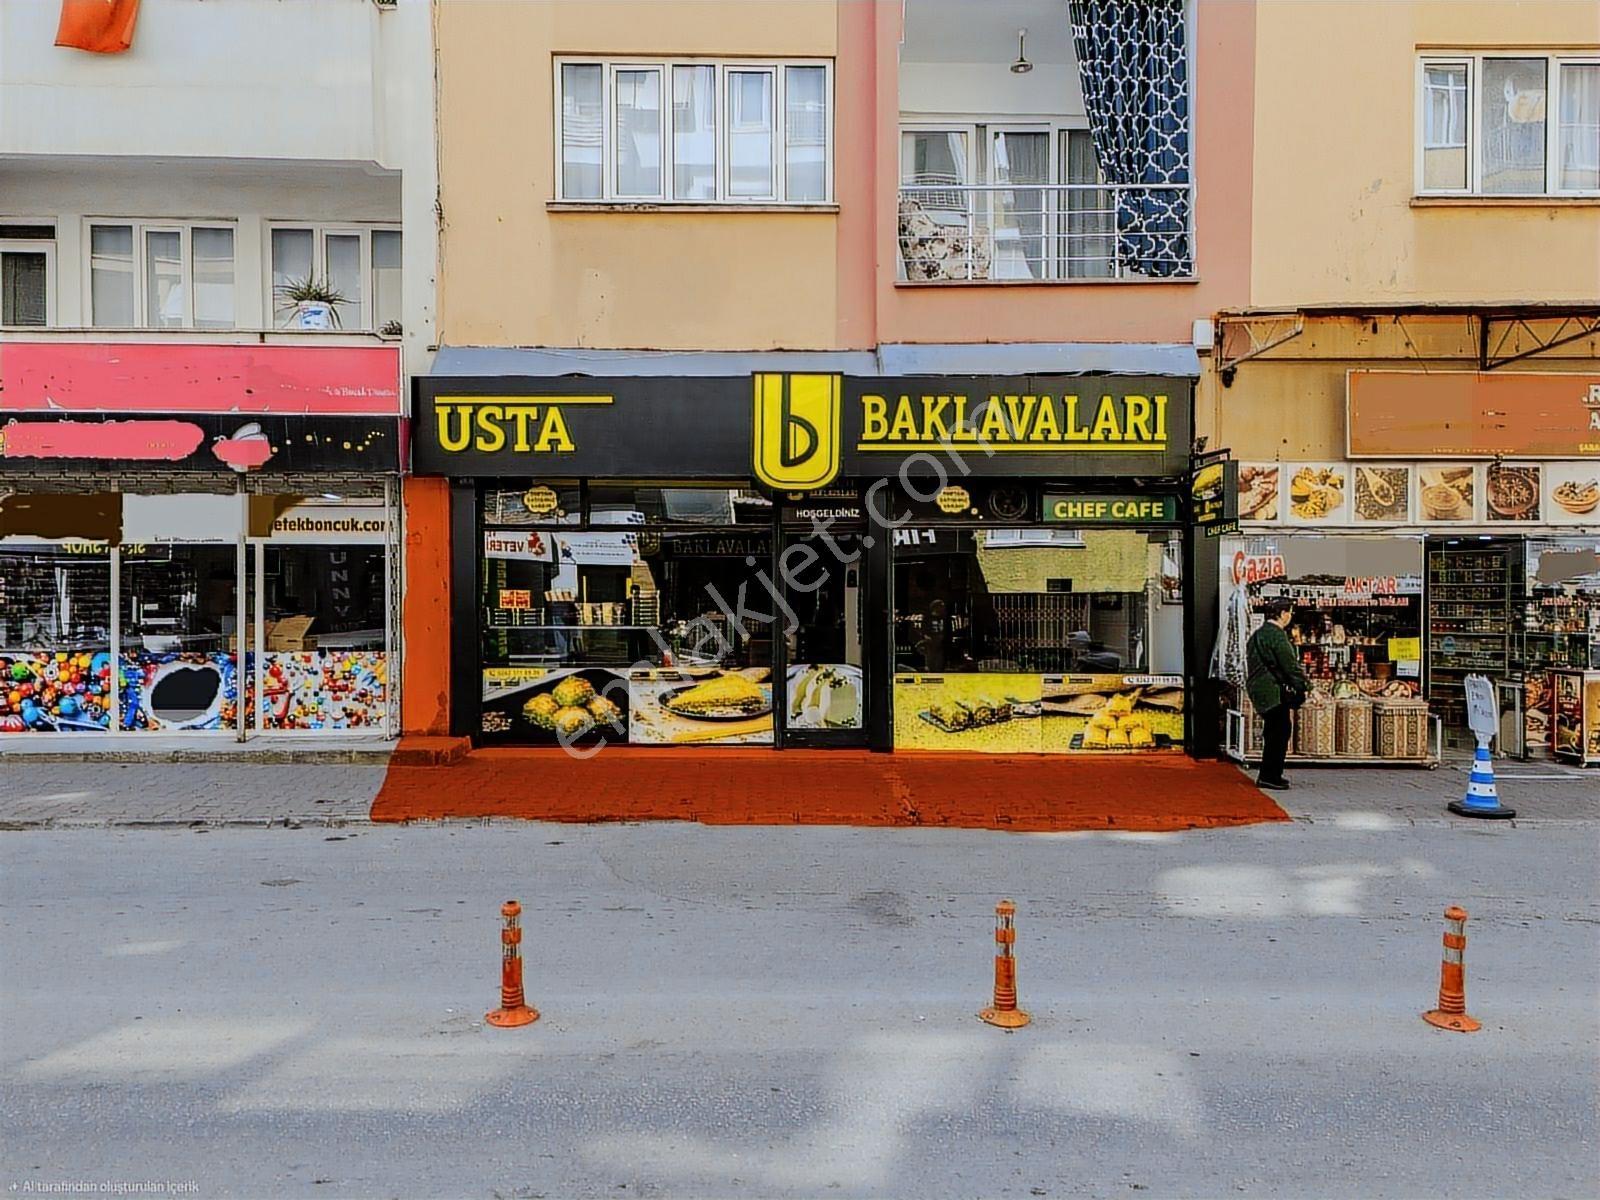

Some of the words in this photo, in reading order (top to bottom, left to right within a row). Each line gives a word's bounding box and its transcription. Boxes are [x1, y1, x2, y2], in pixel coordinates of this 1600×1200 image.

[435, 405, 576, 452] USTA
[861, 395, 1168, 441] BAKLAVALARI
[1055, 501, 1106, 518] CHEF
[1112, 501, 1164, 518] CAFE
[1343, 576, 1397, 594] AKTAR
